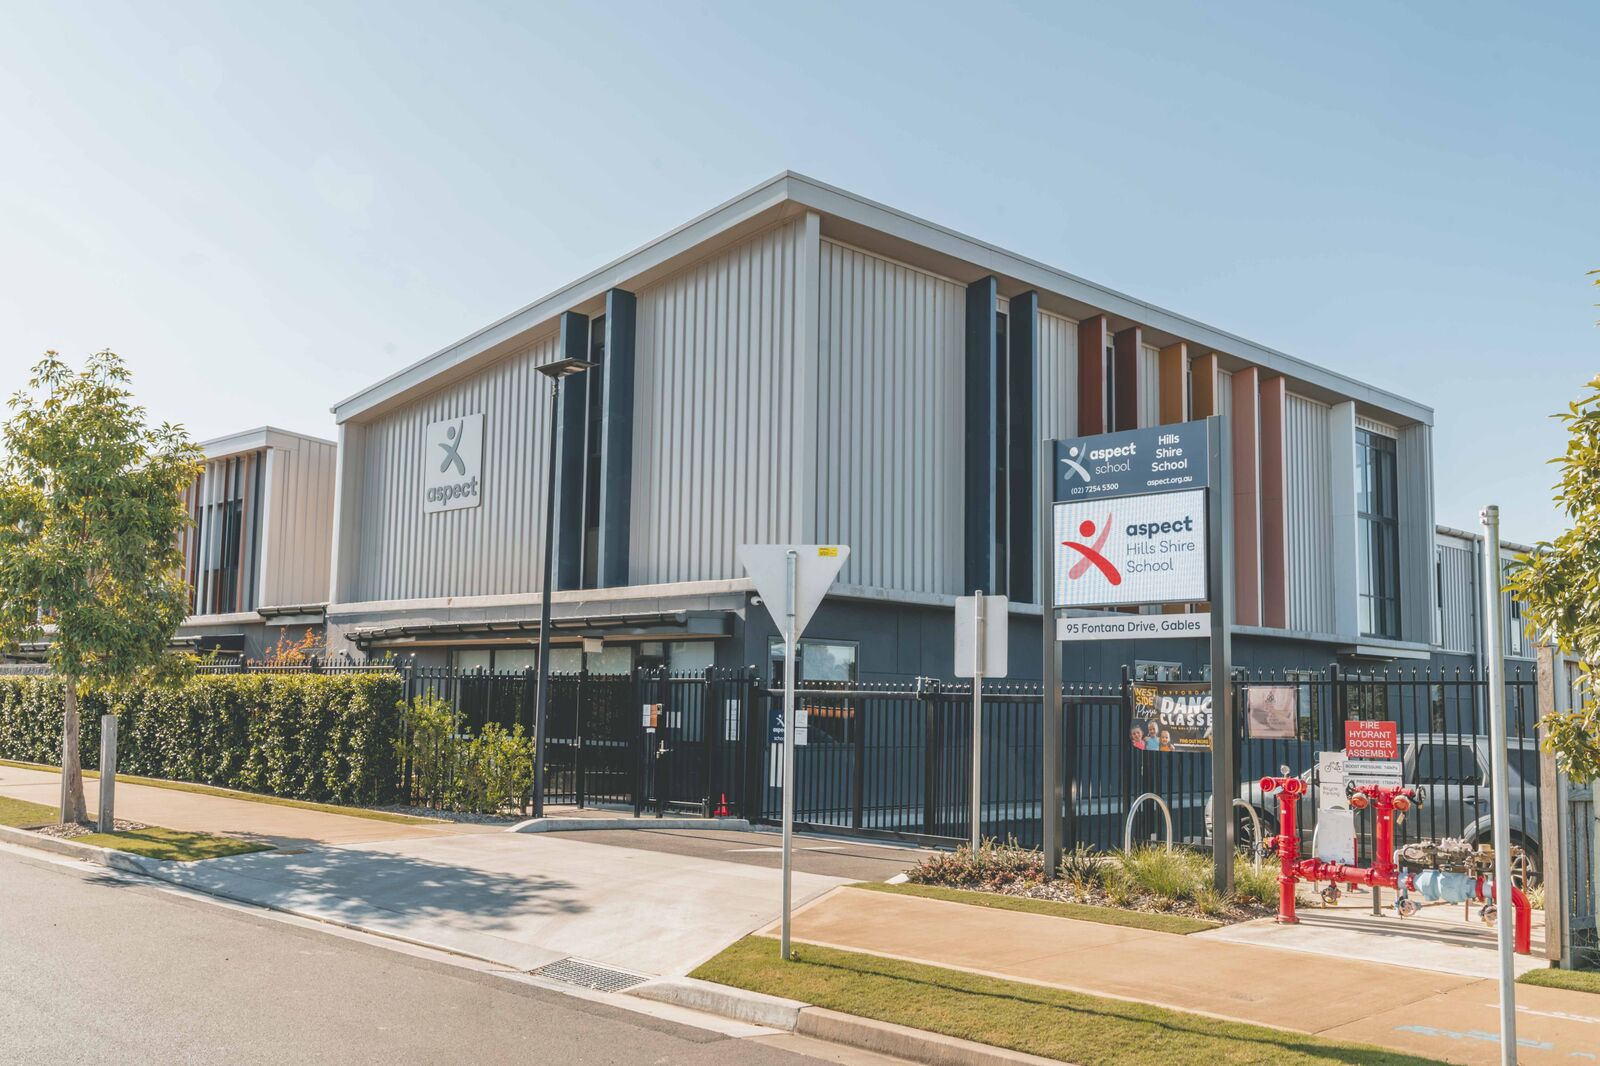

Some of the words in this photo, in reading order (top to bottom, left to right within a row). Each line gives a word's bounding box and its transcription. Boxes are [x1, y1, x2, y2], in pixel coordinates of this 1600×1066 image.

[1158, 433, 1180, 446] Hills
[1089, 441, 1137, 461] aspect
[1155, 447, 1183, 459] Shire
[1095, 458, 1131, 475] school
[1151, 458, 1188, 472] School
[1146, 475, 1193, 487] aspect.org.au
[427, 475, 478, 506] aspect
[1070, 486, 1084, 495] (02)
[1085, 485, 1101, 494] 7254
[1102, 482, 1119, 491] 5300
[1126, 515, 1193, 539] aspect
[1126, 541, 1156, 556] Hills
[1160, 539, 1195, 554] Shire
[1126, 557, 1174, 573] School
[1066, 623, 1079, 634] 95
[1081, 623, 1125, 633] Fontana
[1127, 620, 1159, 633] Drive,
[1161, 619, 1201, 631] Gables
[1133, 687, 1157, 697] WEST
[1136, 697, 1153, 705] SIDE
[1161, 696, 1213, 714] DANC
[1160, 713, 1213, 726] CLASSE
[1360, 721, 1380, 730] FIRE
[1349, 730, 1391, 739] HYDRANT
[1349, 739, 1392, 748] BOOSTER
[1348, 749, 1396, 758] ASSEMBLY
